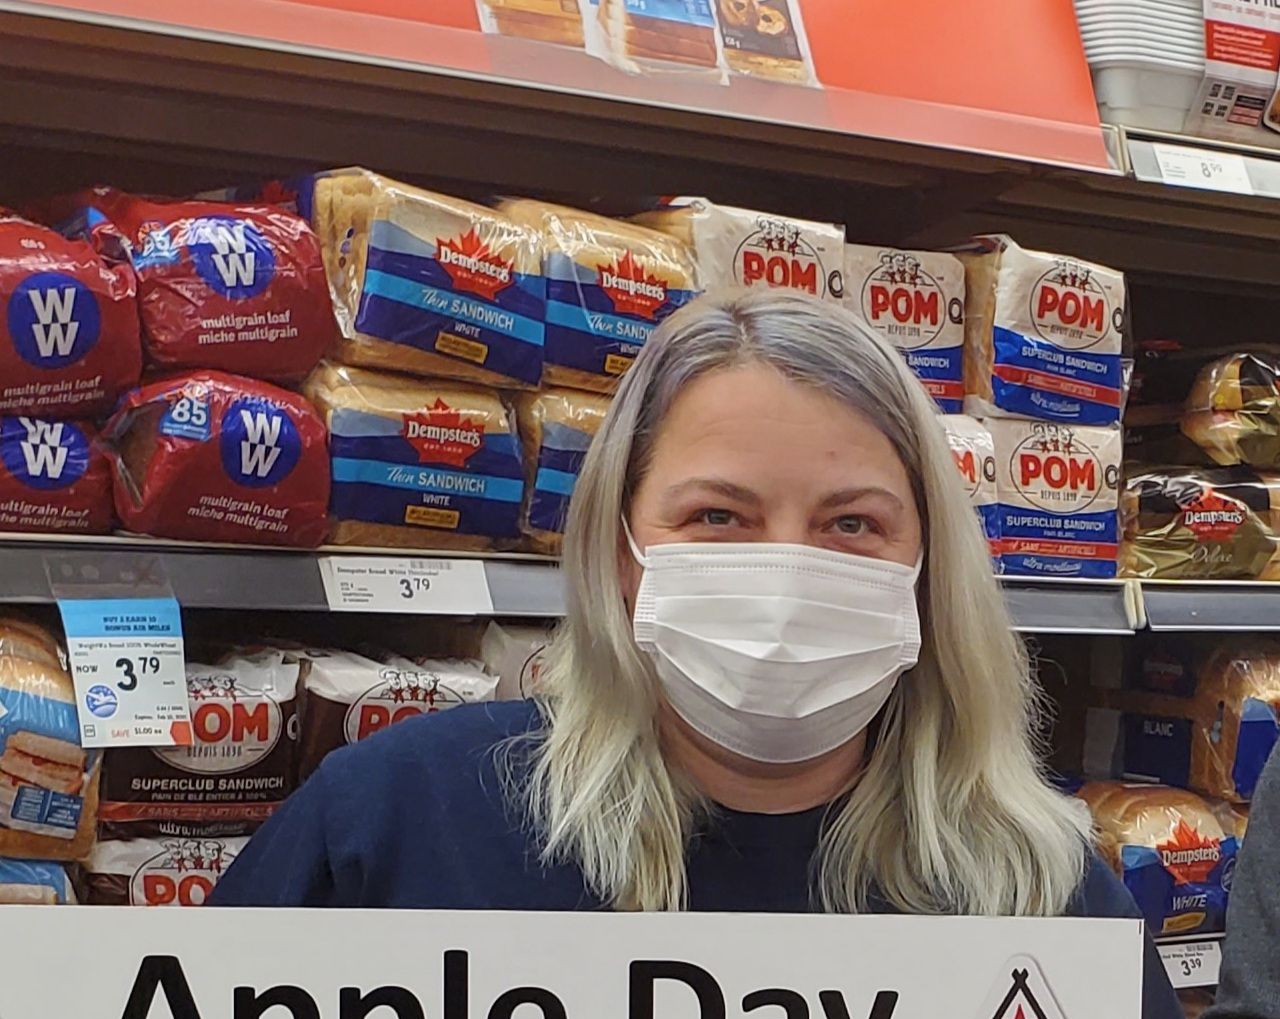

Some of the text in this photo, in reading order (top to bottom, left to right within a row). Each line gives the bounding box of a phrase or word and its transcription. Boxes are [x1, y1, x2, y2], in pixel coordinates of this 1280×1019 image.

[743, 250, 818, 294] POM
[451, 299, 514, 332] SANDWICH
[870, 284, 939, 327] POM
[1037, 285, 1105, 332] POM
[201, 309, 290, 329] multigrain loaf
[454, 321, 482, 339] WHITE
[198, 326, 298, 346] miche multigrain
[1022, 345, 1108, 375] SUPERCLUB SANDWICH
[4, 375, 102, 398] multigrain loaf
[171, 400, 208, 427] 85
[407, 420, 481, 448] Dempster's
[418, 472, 486, 494] SANDWICH
[1020, 454, 1096, 492] POM
[200, 495, 288, 520] multigrain loaf
[422, 493, 451, 506] WHITE
[188, 506, 289, 534] miche multigrain
[1006, 515, 1106, 531] SUPERCLUB SANDWICH
[76, 665, 99, 673] NOW
[111, 729, 131, 738] SAVE
[190, 703, 269, 743] OM
[1144, 720, 1174, 738] BLANC
[131, 776, 284, 791] SUPERCLUB SANDWICH
[1162, 843, 1222, 867] Dempster's
[1172, 894, 1208, 912] WHITE
